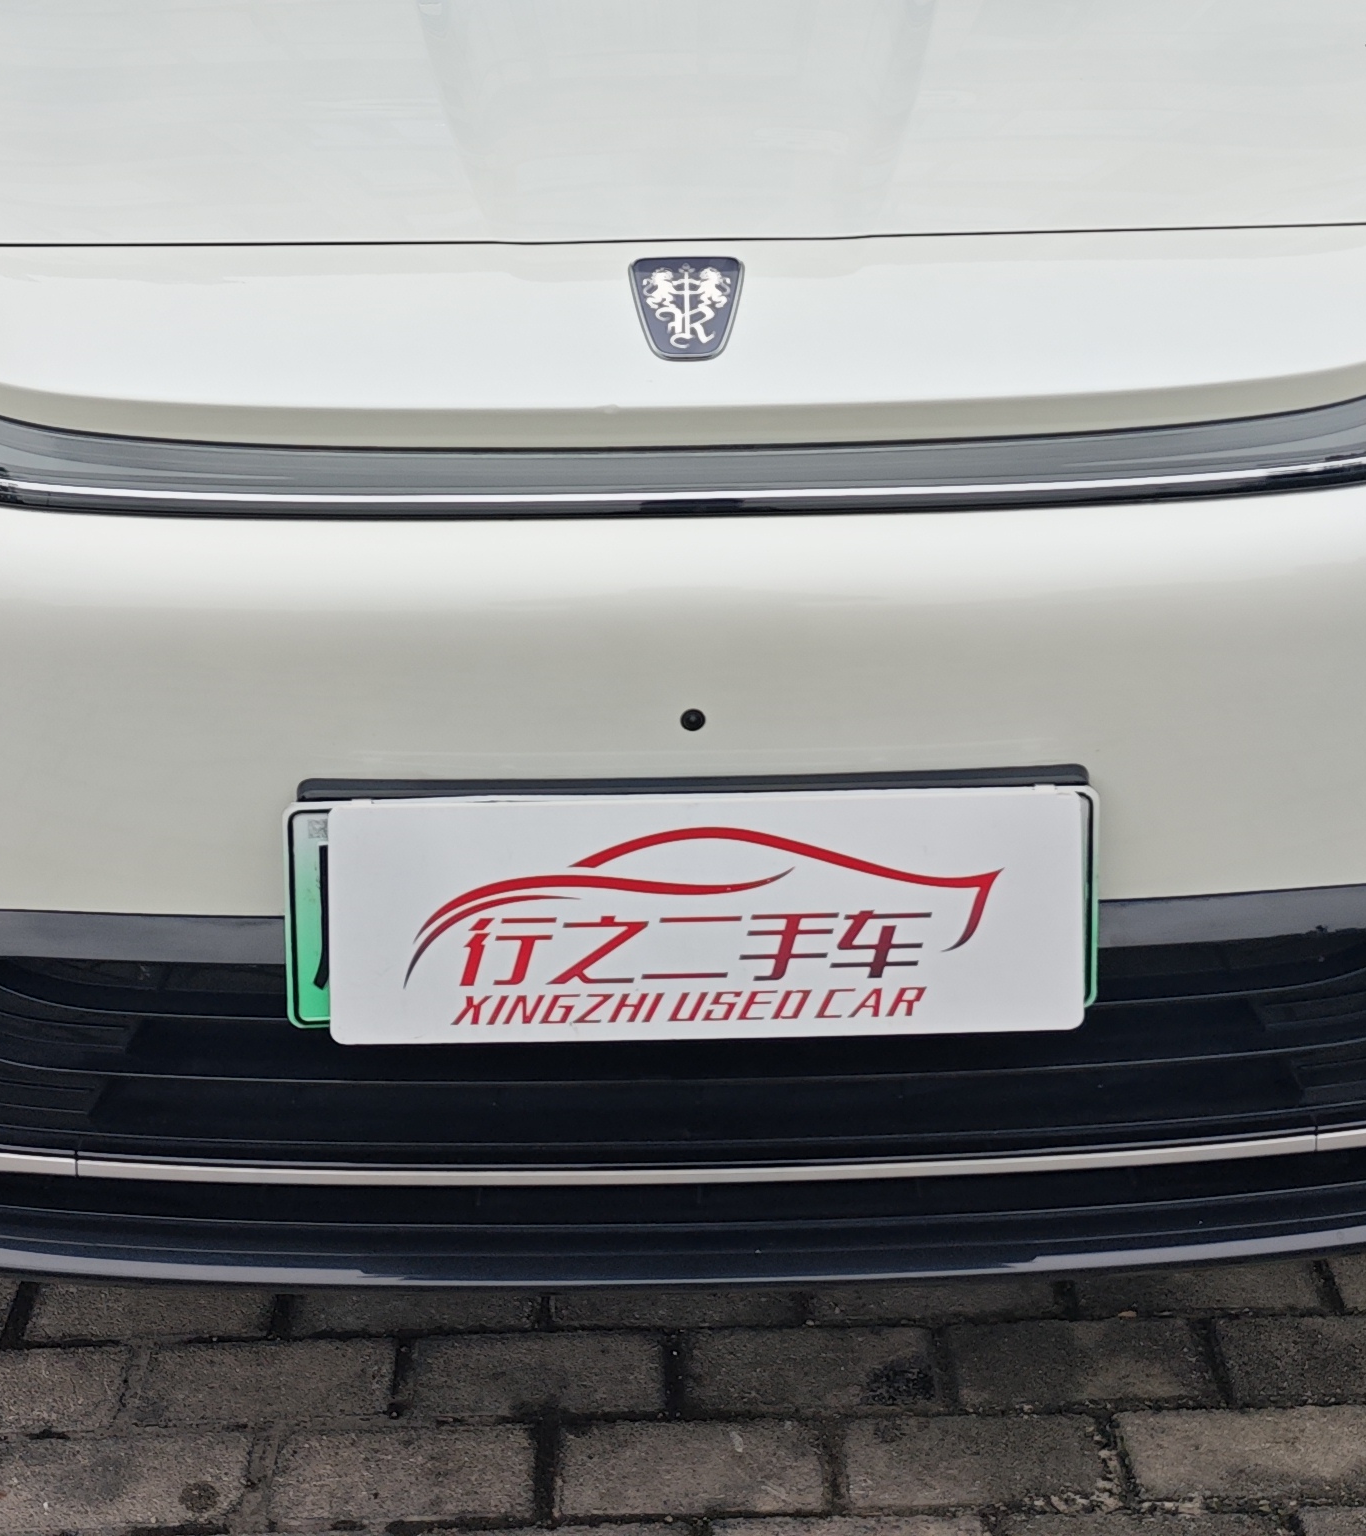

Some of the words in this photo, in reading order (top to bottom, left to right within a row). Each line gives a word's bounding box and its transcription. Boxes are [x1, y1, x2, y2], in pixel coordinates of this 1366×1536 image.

[460, 910, 932, 986] 行之二手车
[451, 993, 665, 1026] XINGZHI
[668, 990, 813, 1022] USED
[815, 986, 928, 1020] CAR
